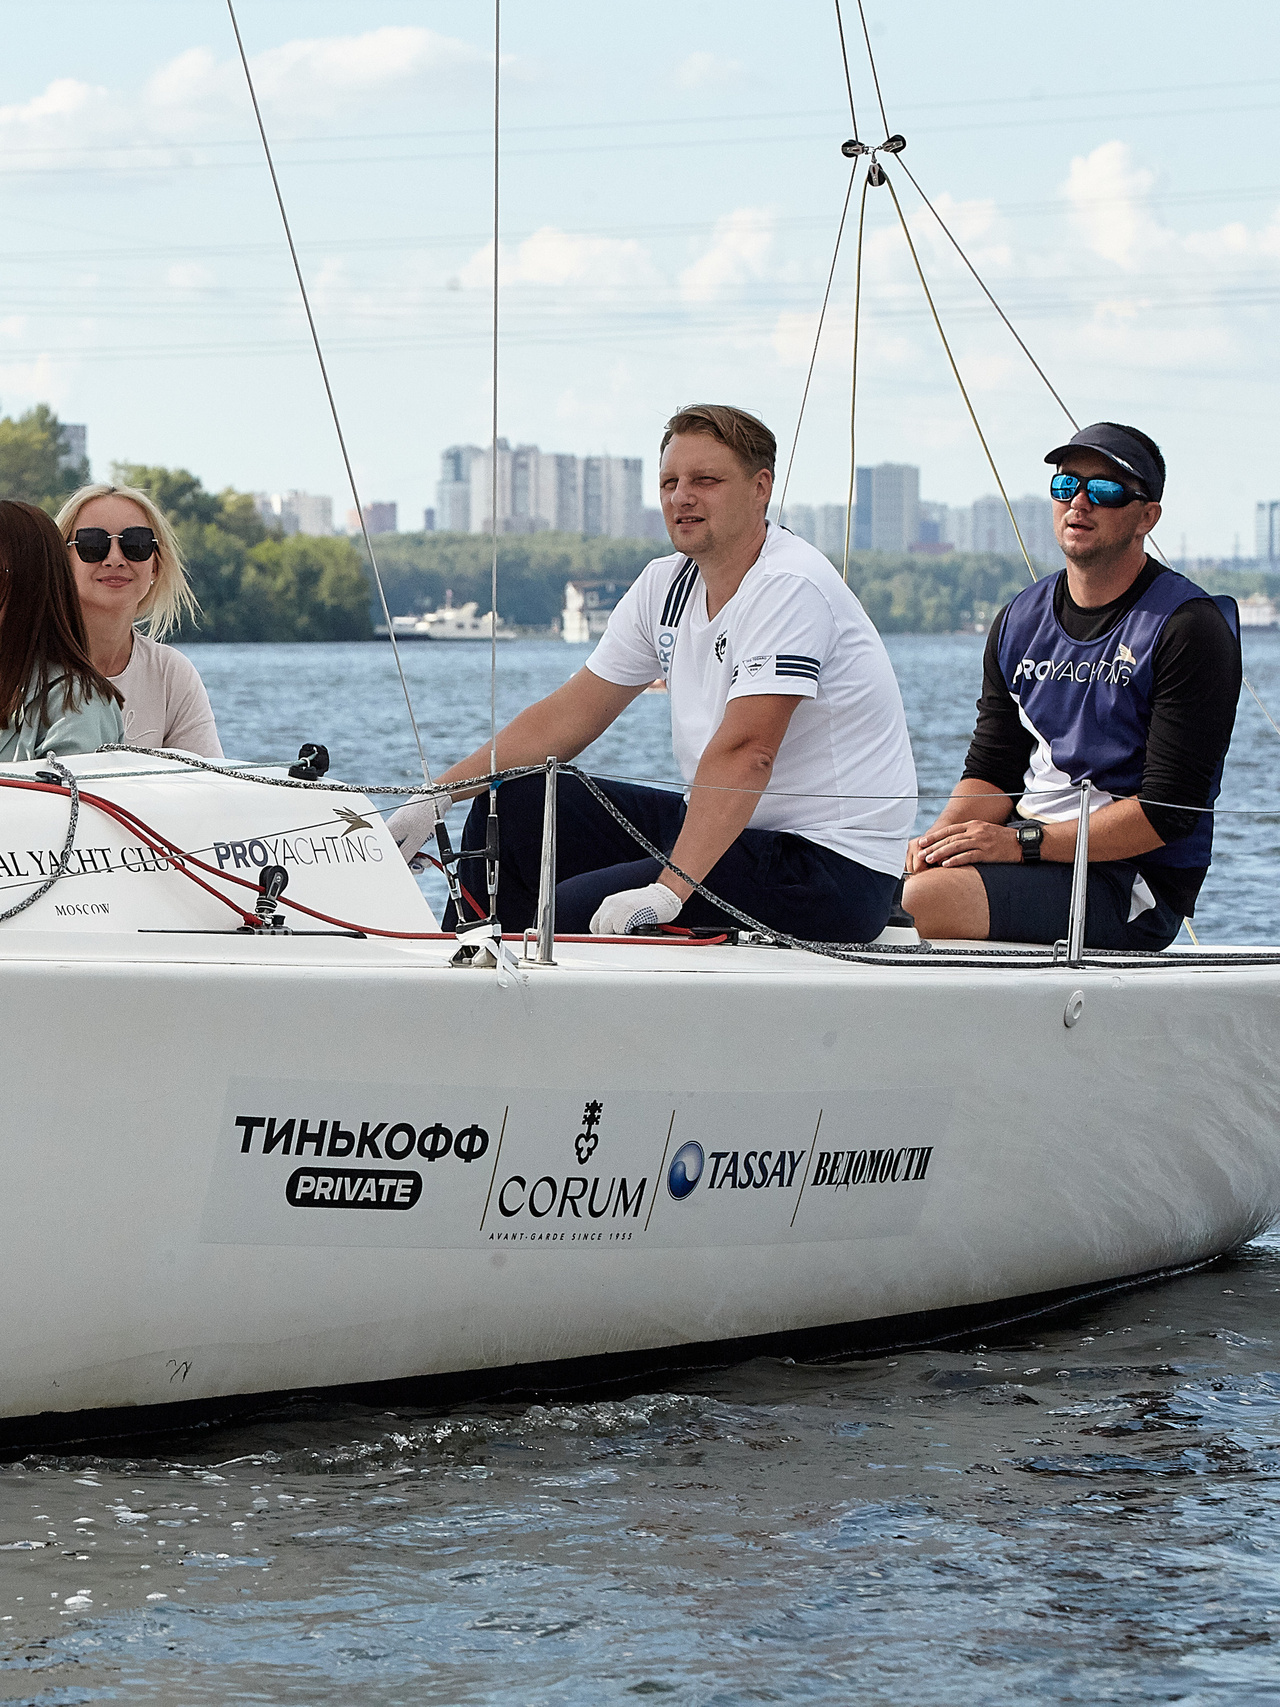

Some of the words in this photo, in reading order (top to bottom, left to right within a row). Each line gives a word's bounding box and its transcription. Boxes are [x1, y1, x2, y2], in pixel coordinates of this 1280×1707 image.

[658, 632, 674, 673] RO
[26, 847, 115, 875] YACHT
[213, 835, 384, 870] PROYACHTING
[54, 903, 110, 917] MOSCOW
[234, 1115, 490, 1164] ТИНЬКОФФ
[707, 1150, 807, 1190] TASSAY
[810, 1146, 934, 1193] ВЕДОМОСТИ
[295, 1175, 414, 1204] PRIVATE
[498, 1175, 648, 1219] CORUM
[571, 1232, 602, 1241] SINCE
[608, 1232, 633, 1241] 1955
